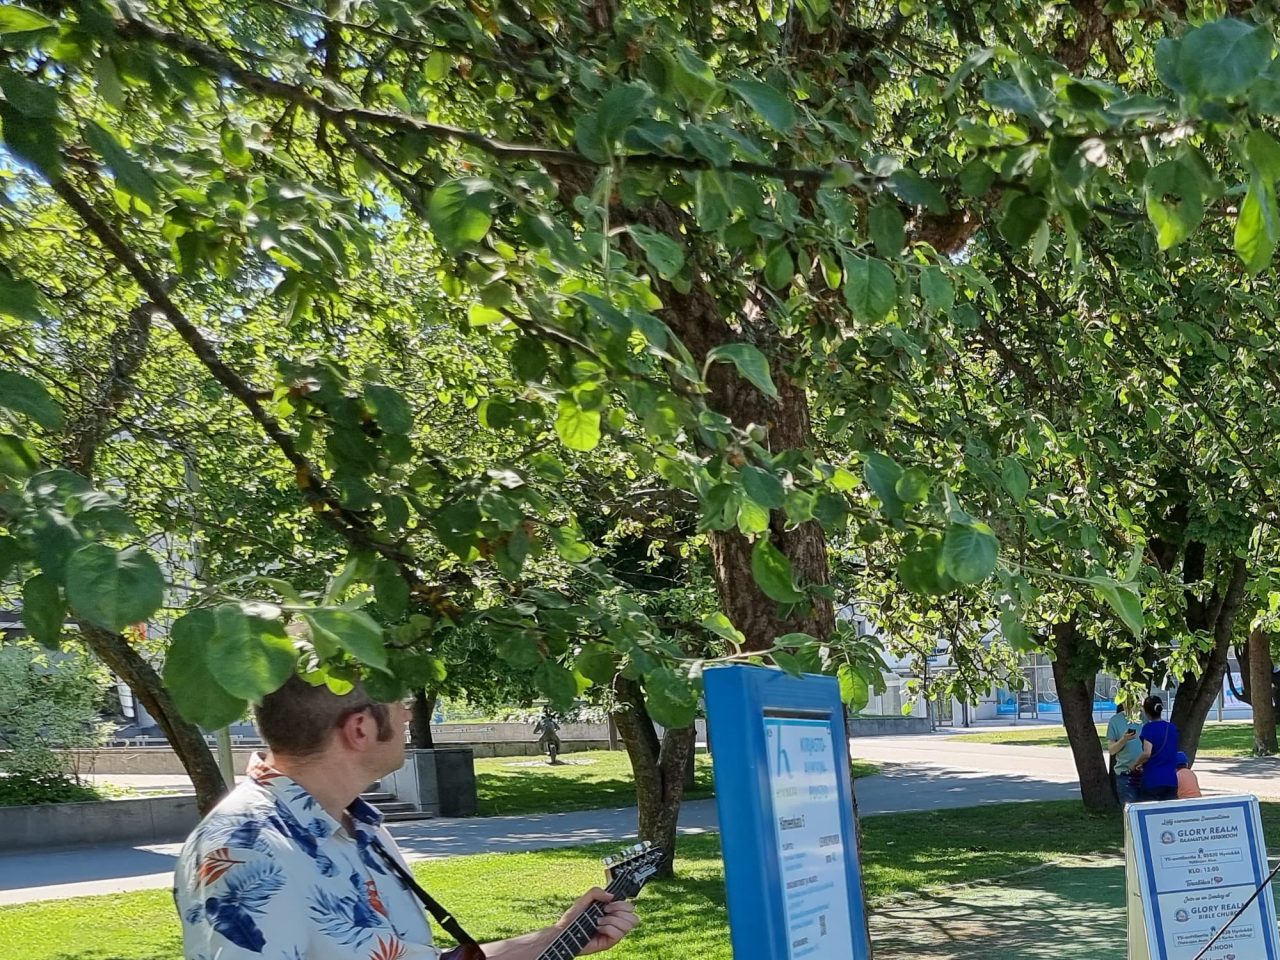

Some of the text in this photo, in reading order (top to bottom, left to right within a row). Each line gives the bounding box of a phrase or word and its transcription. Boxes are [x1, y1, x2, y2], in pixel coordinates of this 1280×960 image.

[1178, 825, 1239, 837] GLORY REALM
[1191, 904, 1219, 914] GLORY
